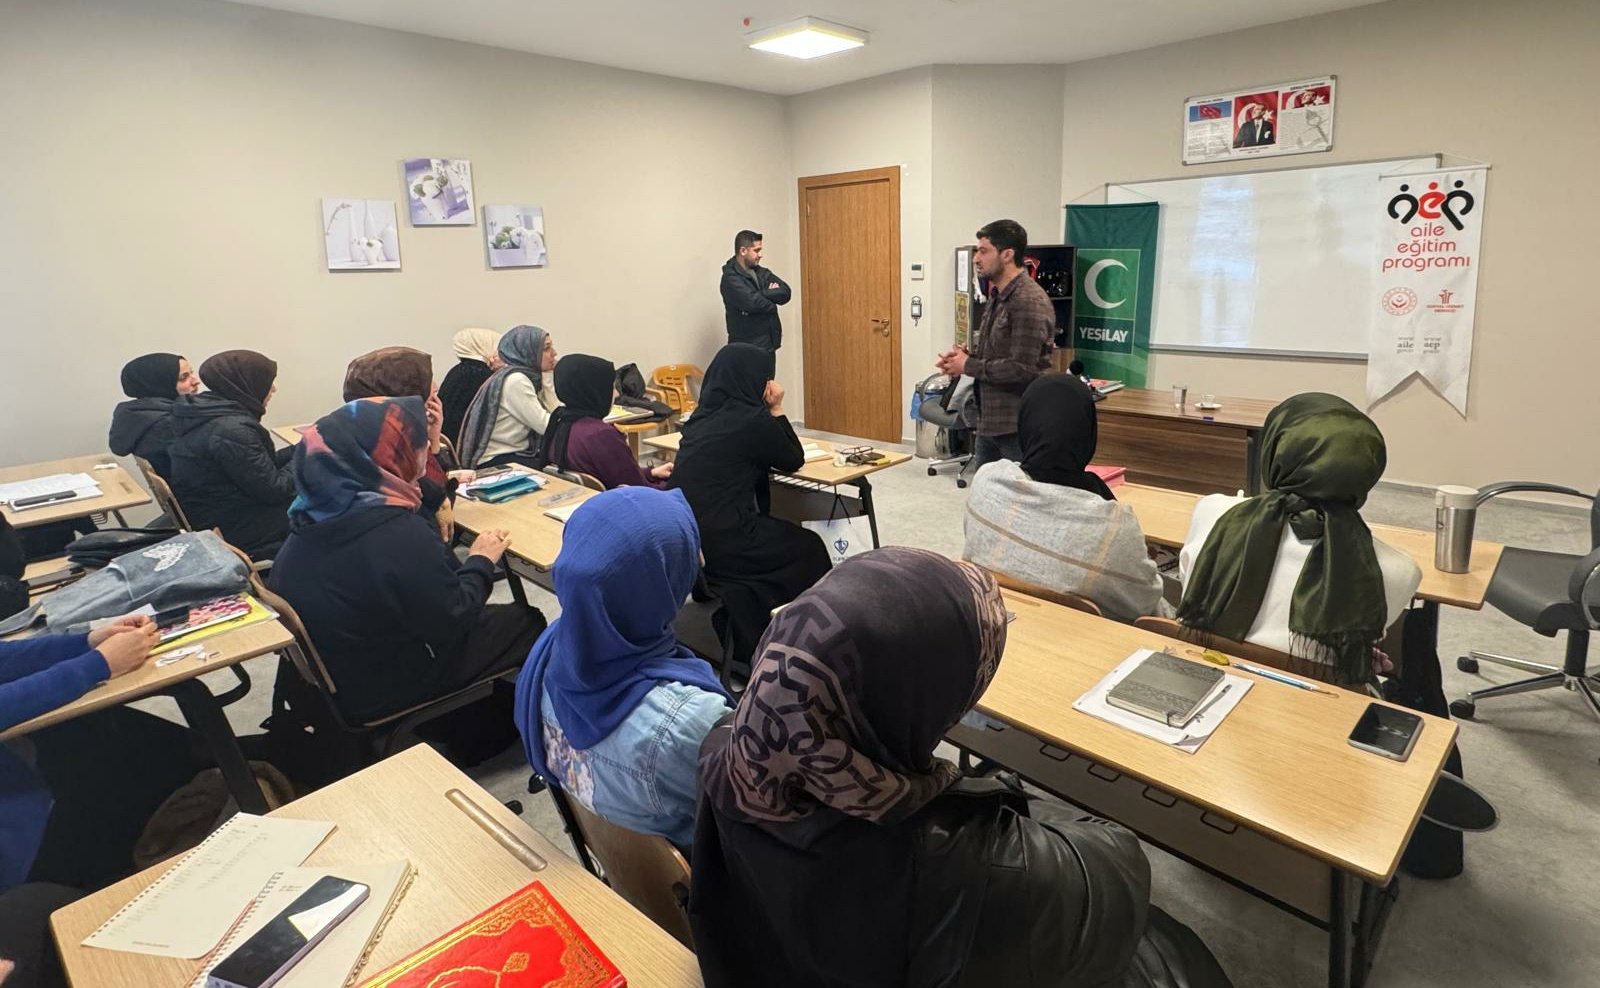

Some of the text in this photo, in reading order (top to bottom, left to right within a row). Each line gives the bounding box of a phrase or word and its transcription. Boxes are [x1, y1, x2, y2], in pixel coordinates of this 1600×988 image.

[1410, 222, 1445, 237] aile
[1397, 239, 1456, 257] eğitim
[1382, 256, 1470, 272] programı
